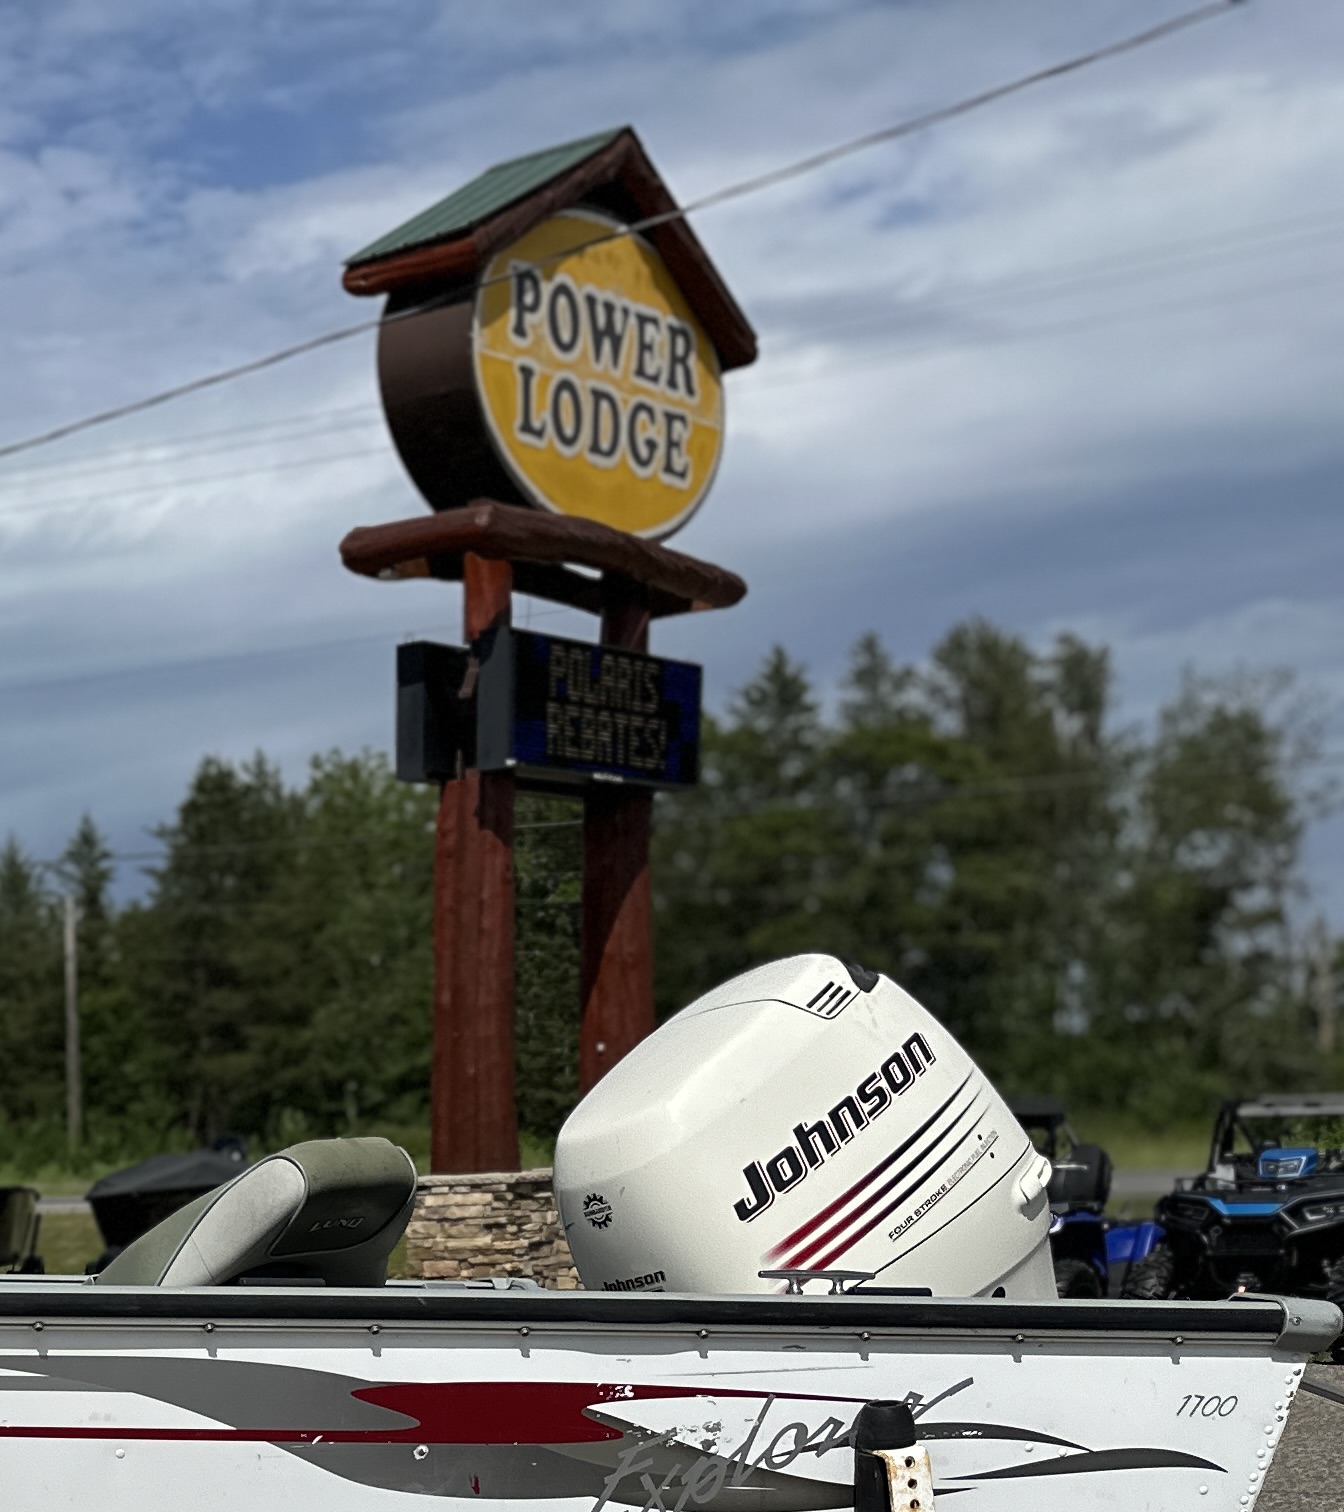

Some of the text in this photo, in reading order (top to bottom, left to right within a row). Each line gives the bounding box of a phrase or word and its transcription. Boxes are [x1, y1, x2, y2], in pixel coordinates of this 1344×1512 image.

[512, 264, 696, 398] POWER
[518, 364, 690, 481] LODGE
[549, 644, 660, 714] POLARIS
[546, 701, 667, 770] REBATES!
[733, 1032, 936, 1223] Johnson
[888, 1215, 914, 1240] FOUR
[914, 1184, 949, 1217] STROKE
[1176, 1394, 1238, 1417] 1700
